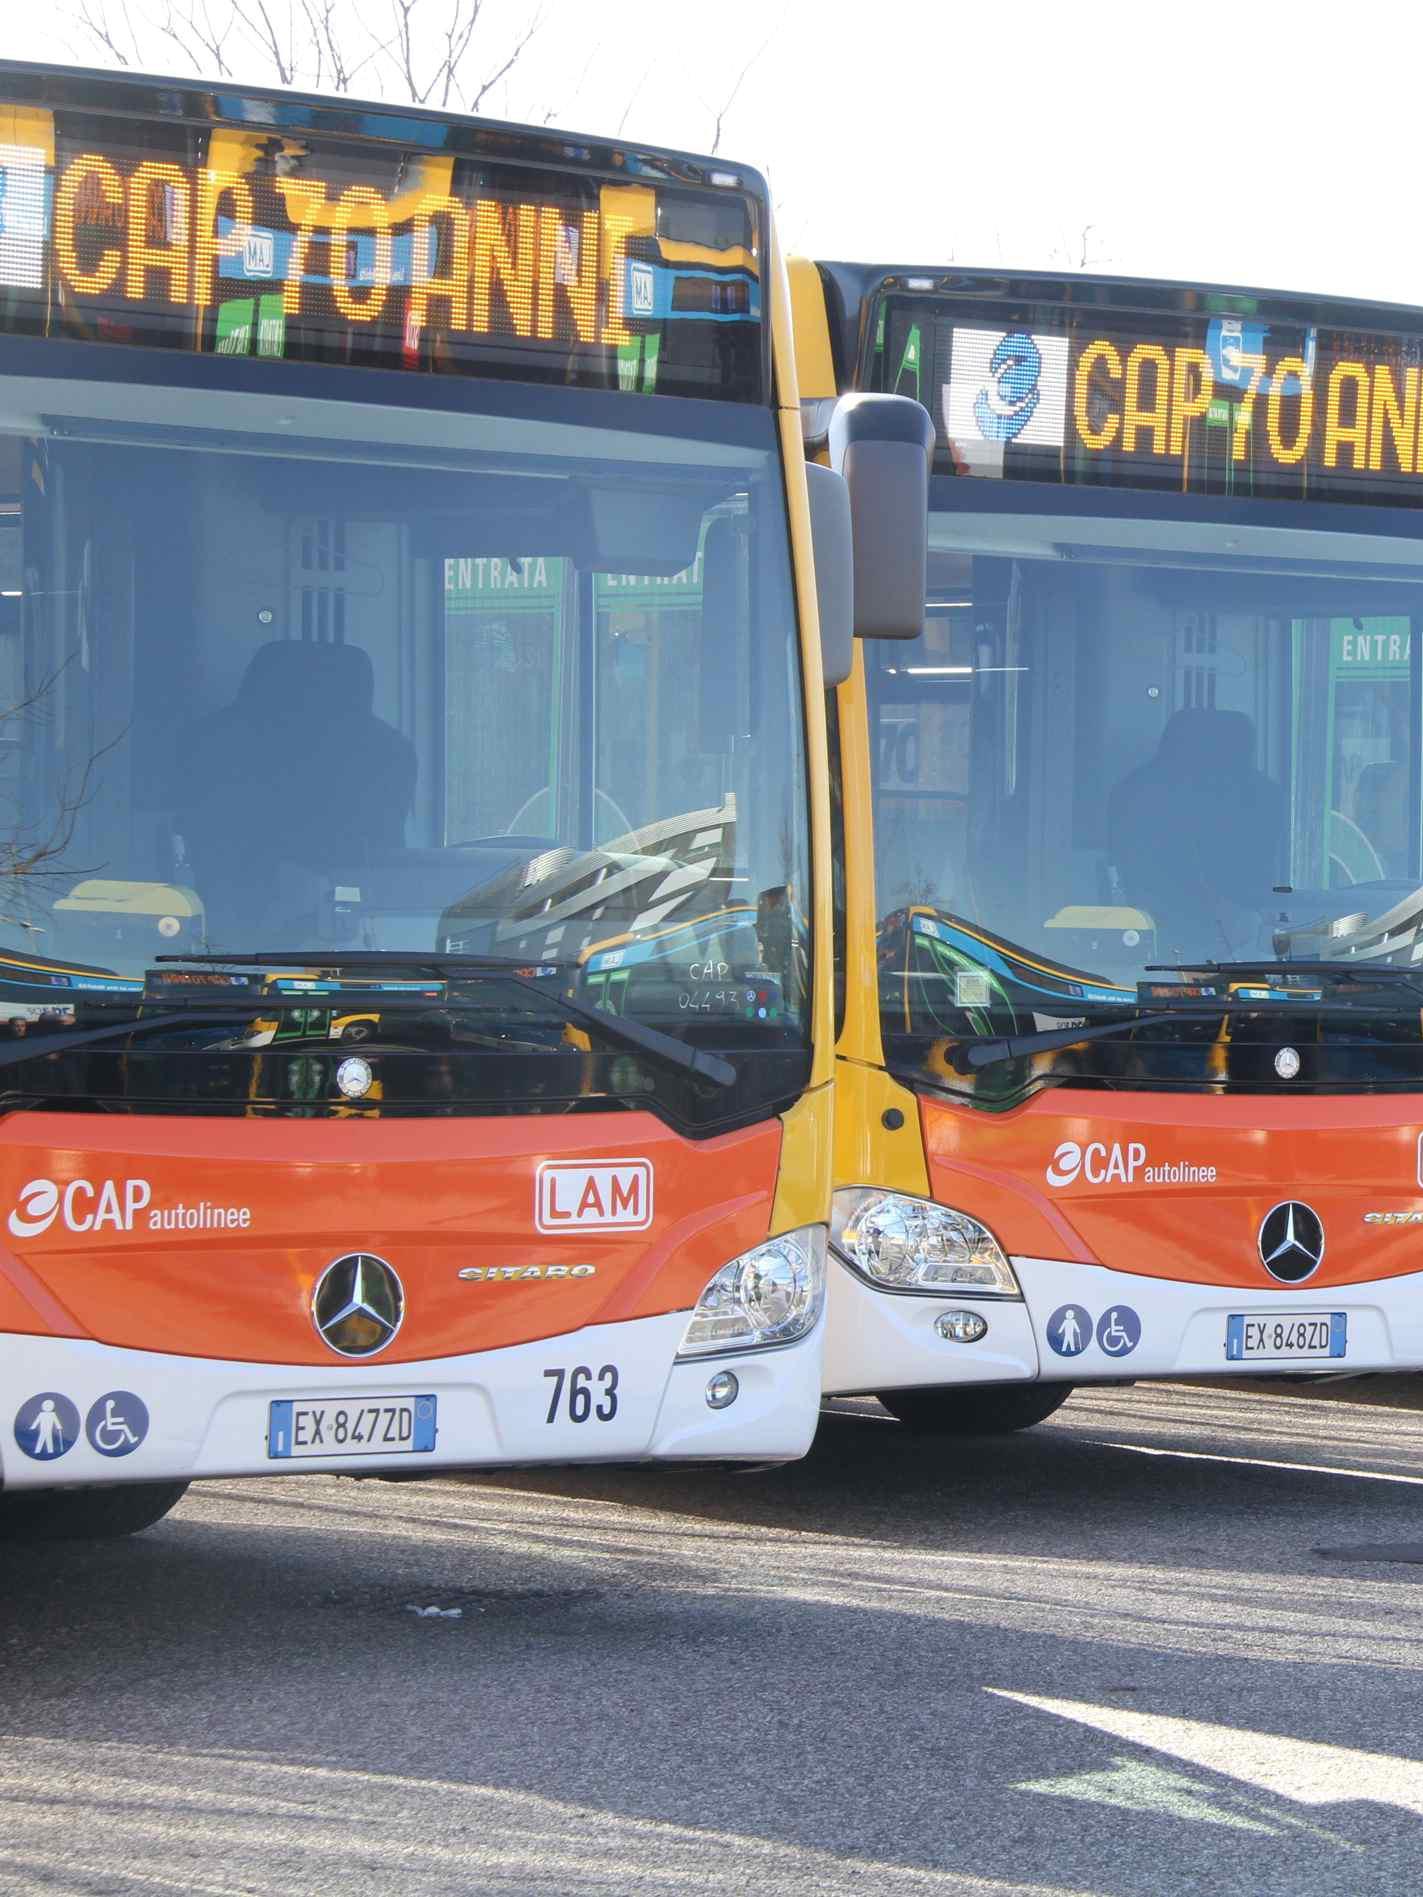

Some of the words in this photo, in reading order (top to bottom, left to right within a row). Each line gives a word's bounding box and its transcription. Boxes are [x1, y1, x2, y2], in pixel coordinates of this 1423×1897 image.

[55, 153, 254, 306] CAP
[275, 175, 392, 322] 70
[409, 191, 638, 346] ANNI
[1073, 340, 1214, 456] CAP
[1229, 352, 1313, 465] 70
[689, 959, 729, 981] CAP
[1083, 1143, 1146, 1185] CAP
[1144, 1160, 1217, 1183] autolinee
[63, 1178, 152, 1233] CAP
[148, 1201, 251, 1231] autolinee
[547, 1172, 642, 1219] LAM
[457, 1263, 597, 1281] CITARO
[543, 1364, 620, 1424] 763
